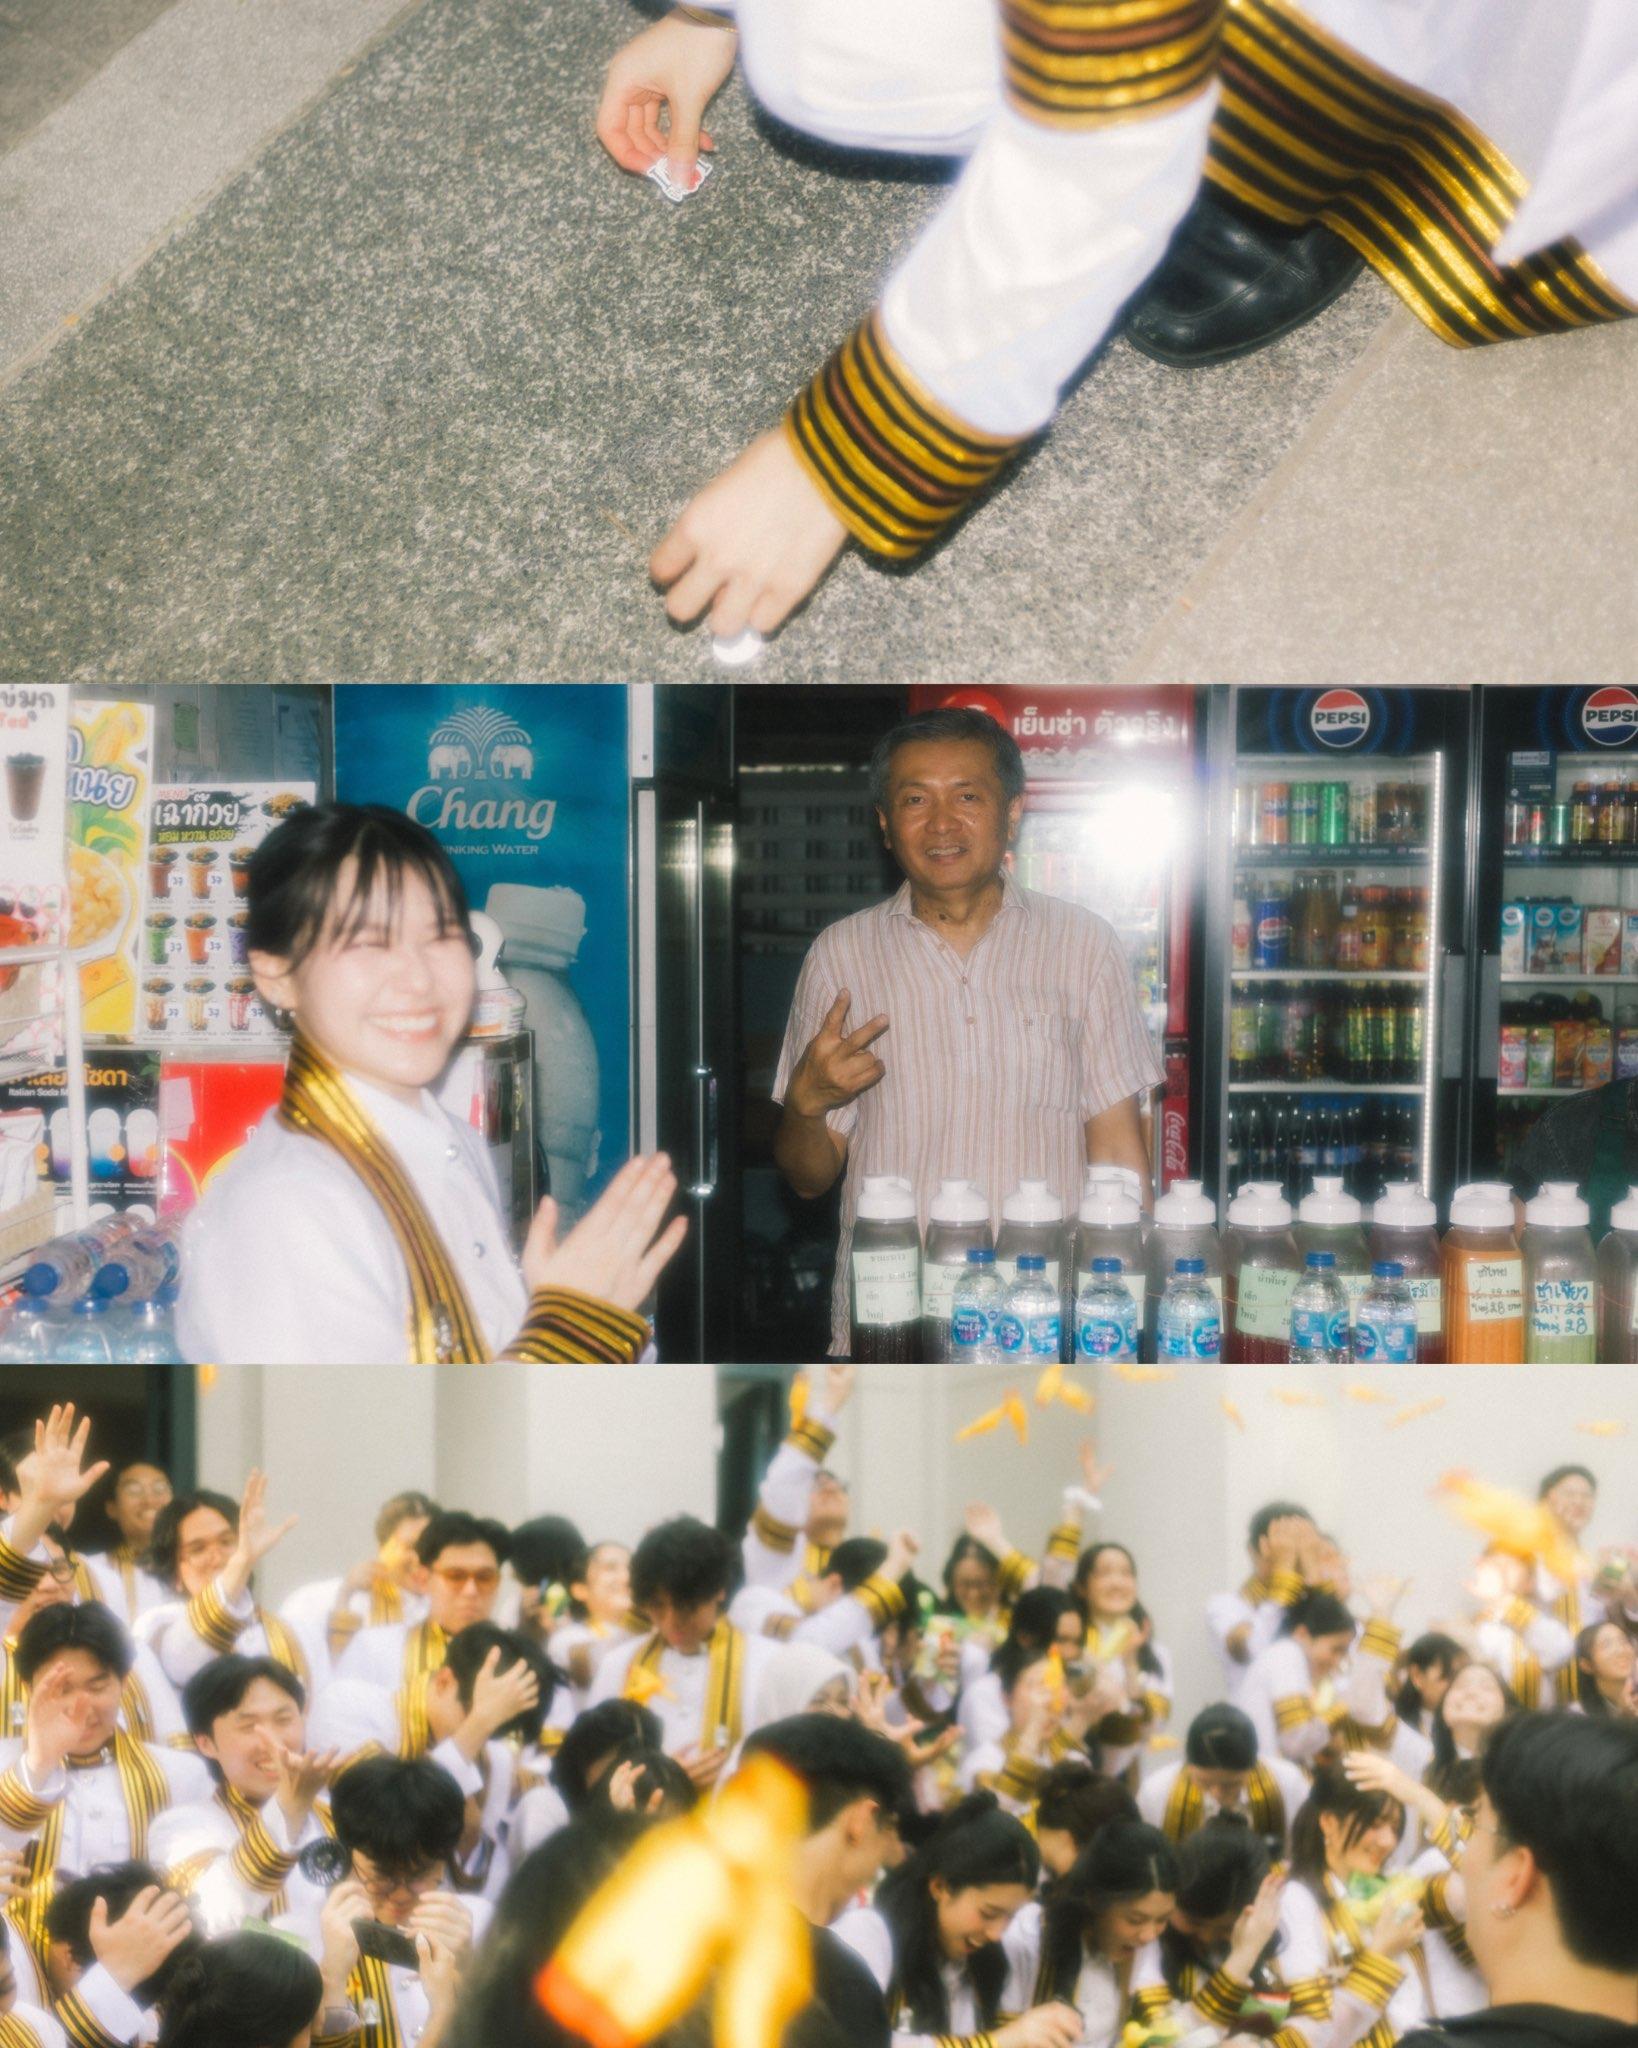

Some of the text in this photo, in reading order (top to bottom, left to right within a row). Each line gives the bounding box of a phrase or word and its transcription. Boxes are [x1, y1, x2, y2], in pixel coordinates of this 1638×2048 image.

[1013, 706, 1087, 736] เย็นซ่า
[1314, 711, 1367, 725] PEPSI
[406, 785, 557, 840] Chang
